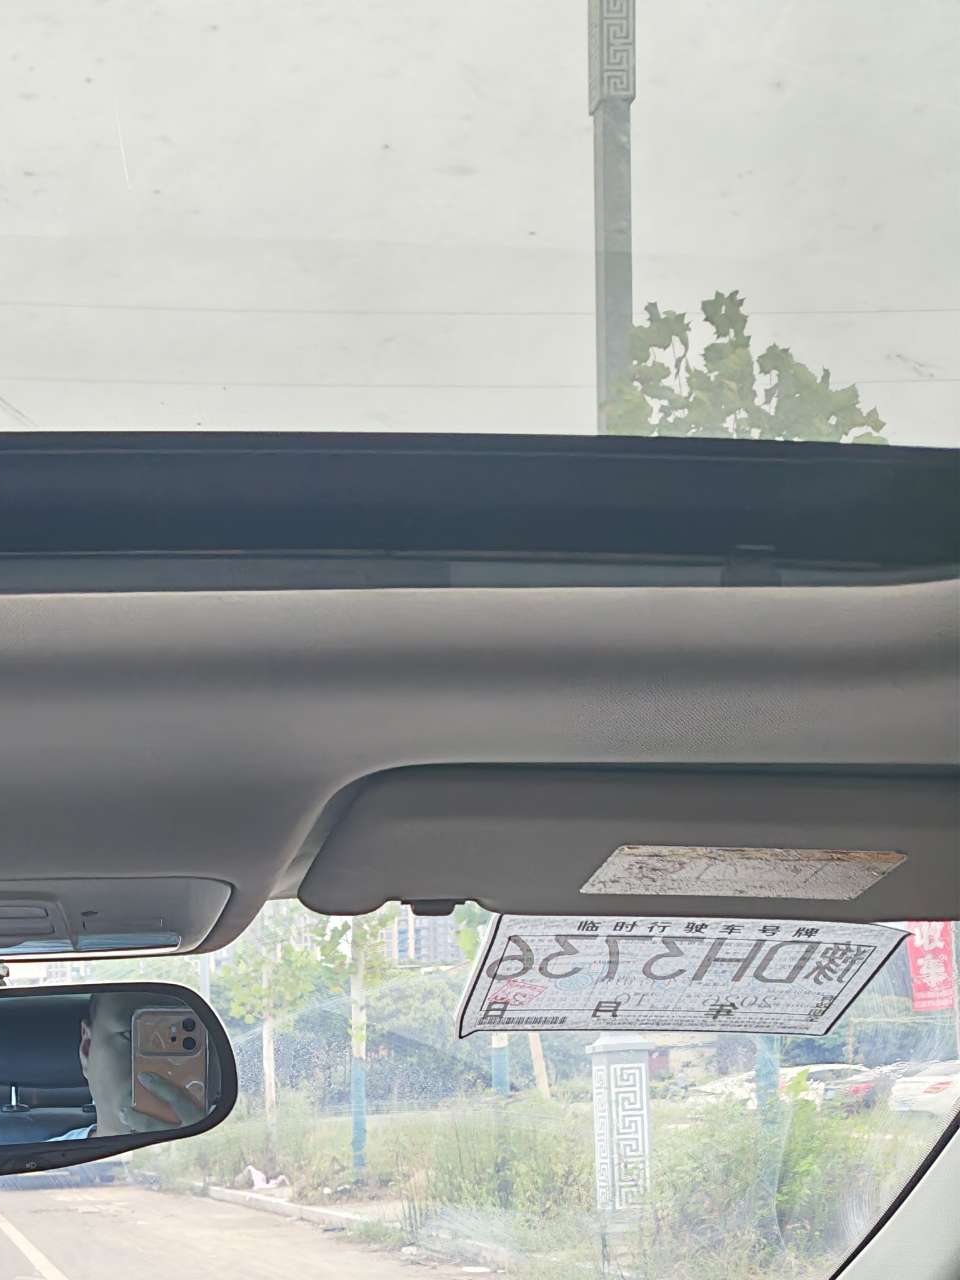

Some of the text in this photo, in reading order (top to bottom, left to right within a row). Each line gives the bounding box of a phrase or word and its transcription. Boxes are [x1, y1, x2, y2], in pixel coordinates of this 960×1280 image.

[576, 919, 820, 938] 临时行驶车号牌
